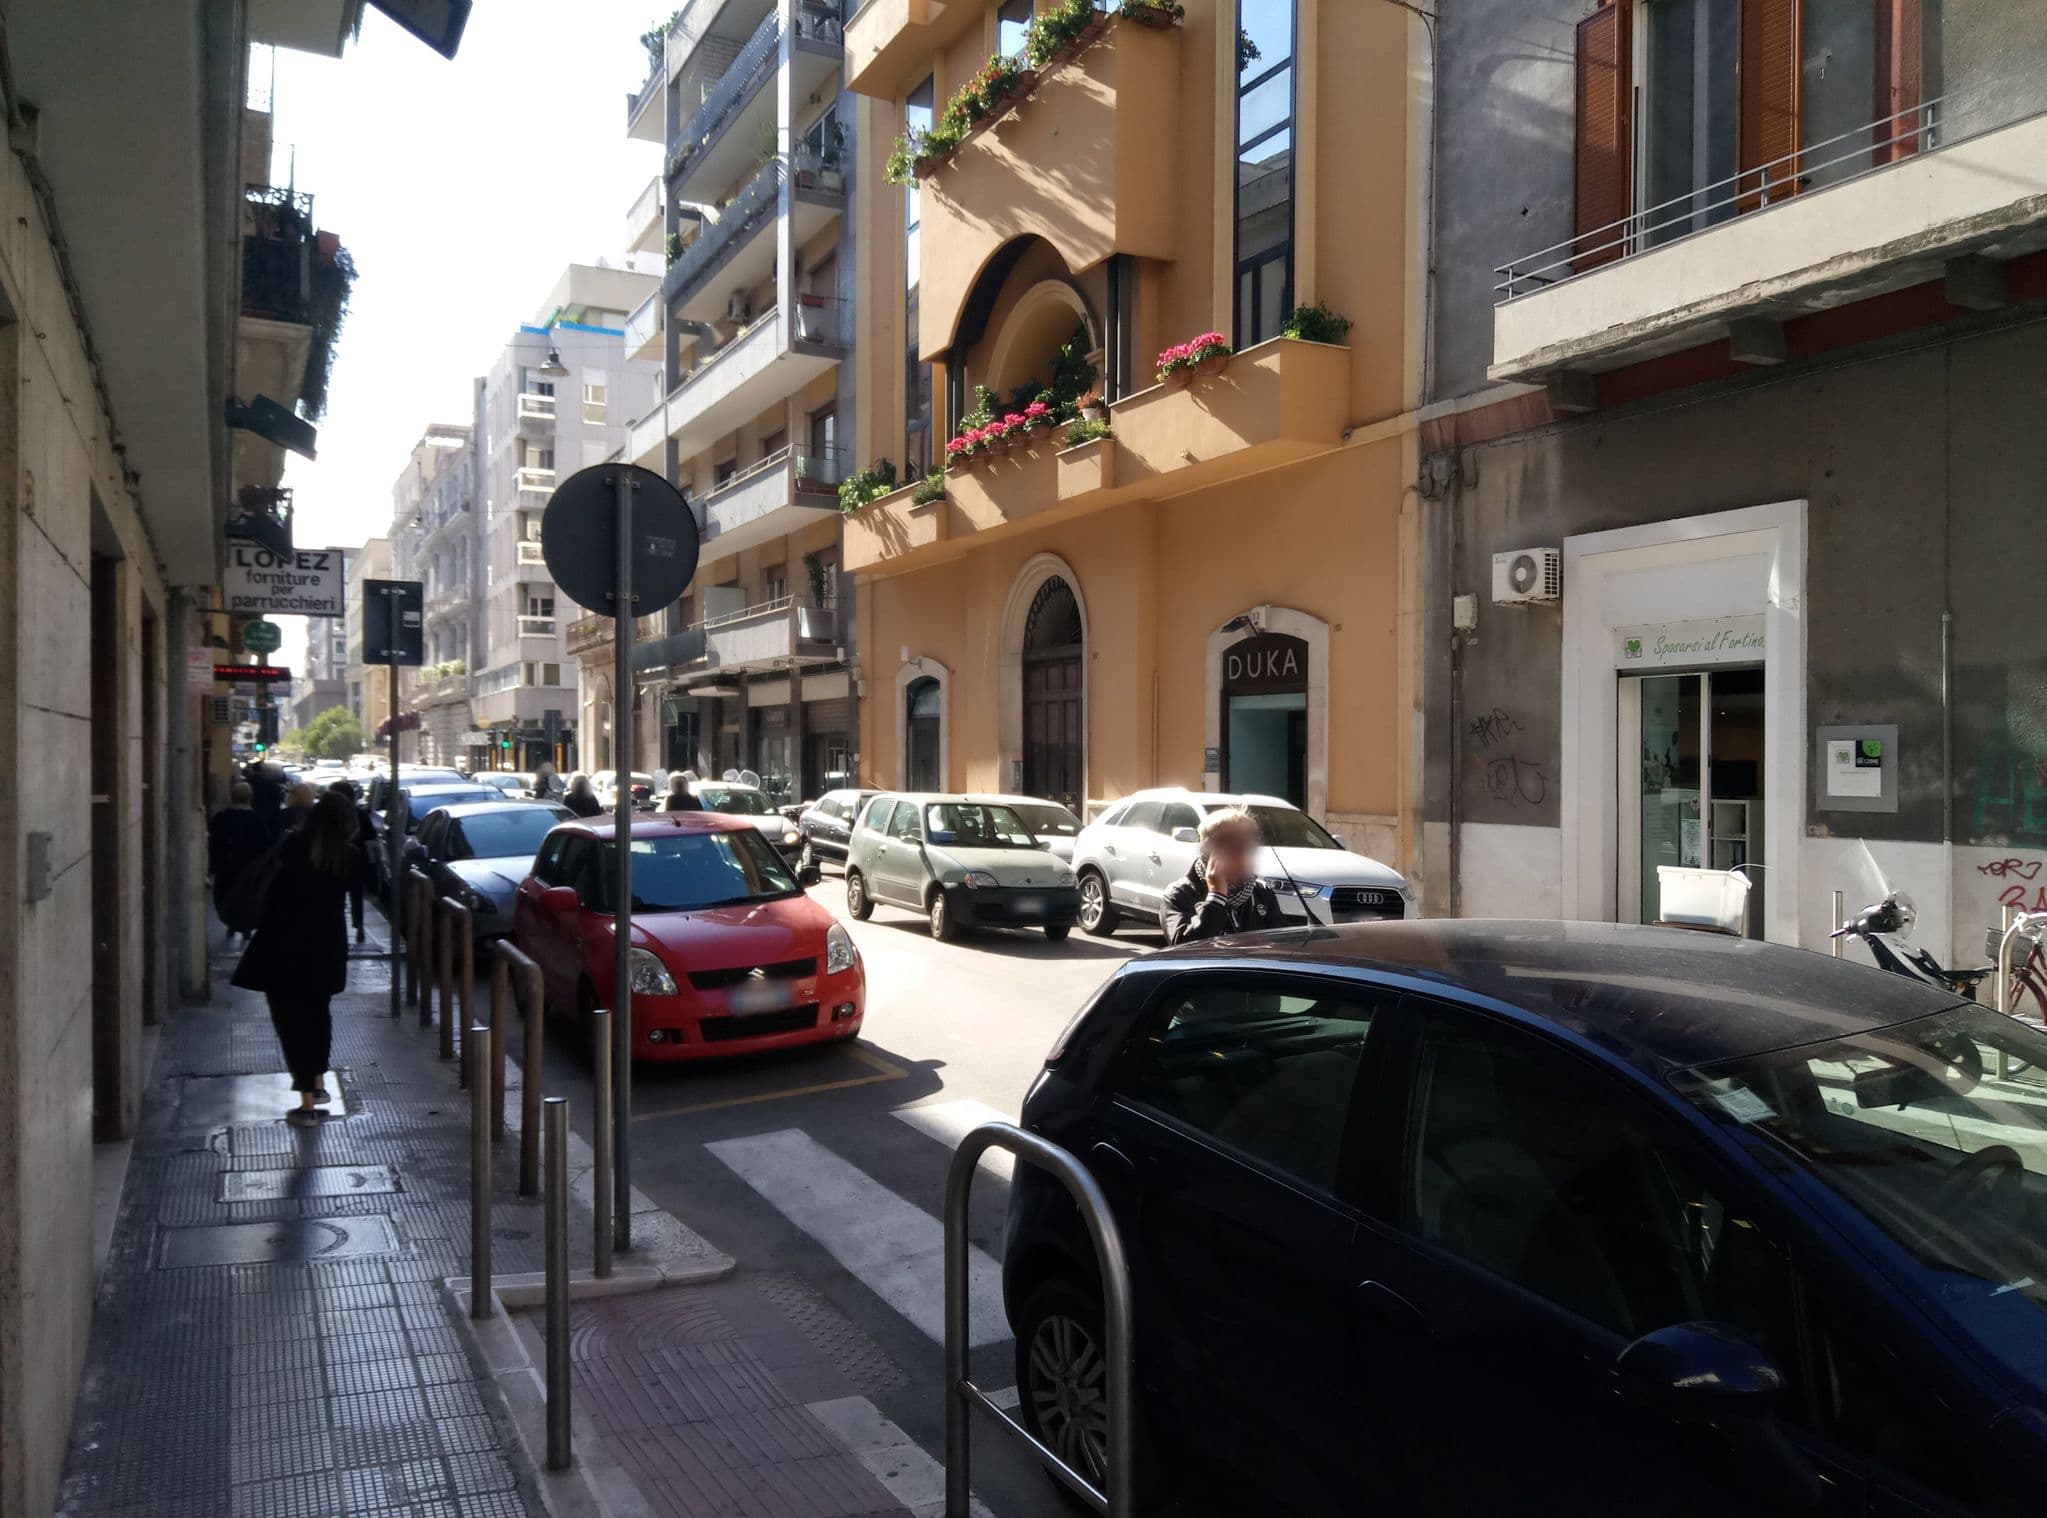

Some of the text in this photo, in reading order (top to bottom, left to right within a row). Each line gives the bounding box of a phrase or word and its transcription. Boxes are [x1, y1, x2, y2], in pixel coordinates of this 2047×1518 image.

[246, 569, 321, 586] forniture
[271, 585, 295, 596] per
[231, 594, 336, 611] parrucchieri
[1704, 631, 1720, 651] al
[1228, 648, 1299, 680] DUKA
